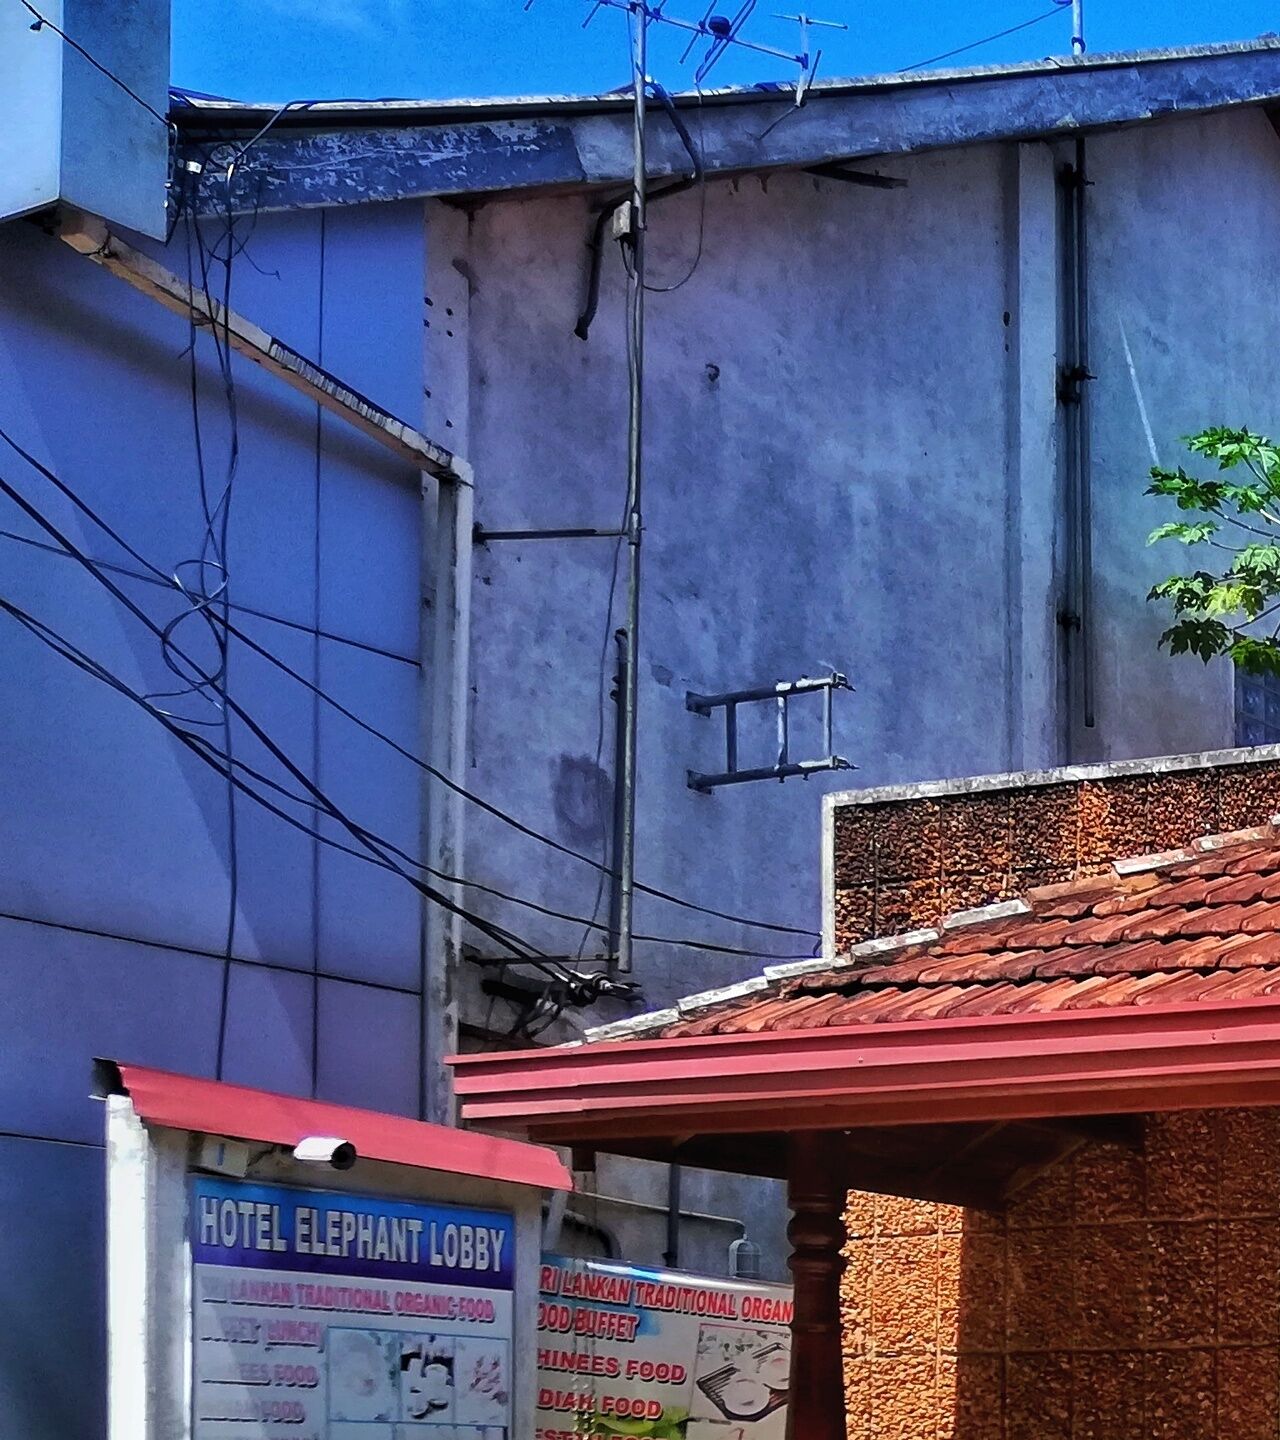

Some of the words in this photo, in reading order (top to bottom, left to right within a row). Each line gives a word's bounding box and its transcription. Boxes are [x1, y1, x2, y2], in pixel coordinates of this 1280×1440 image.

[200, 1196, 287, 1252] HOTEL
[295, 1207, 424, 1264] ELEPHANT
[429, 1221, 506, 1273] LOBBY
[539, 1265, 559, 1294] RI
[561, 1269, 633, 1304] LANKAN
[635, 1281, 738, 1319] TRADITIONAL
[740, 1295, 794, 1324] ORGAN
[537, 1302, 571, 1330] OOD
[574, 1308, 638, 1341] BUFFET
[537, 1347, 620, 1377] HINEES
[625, 1358, 687, 1384] FOOD
[601, 1395, 663, 1420] FOOD
